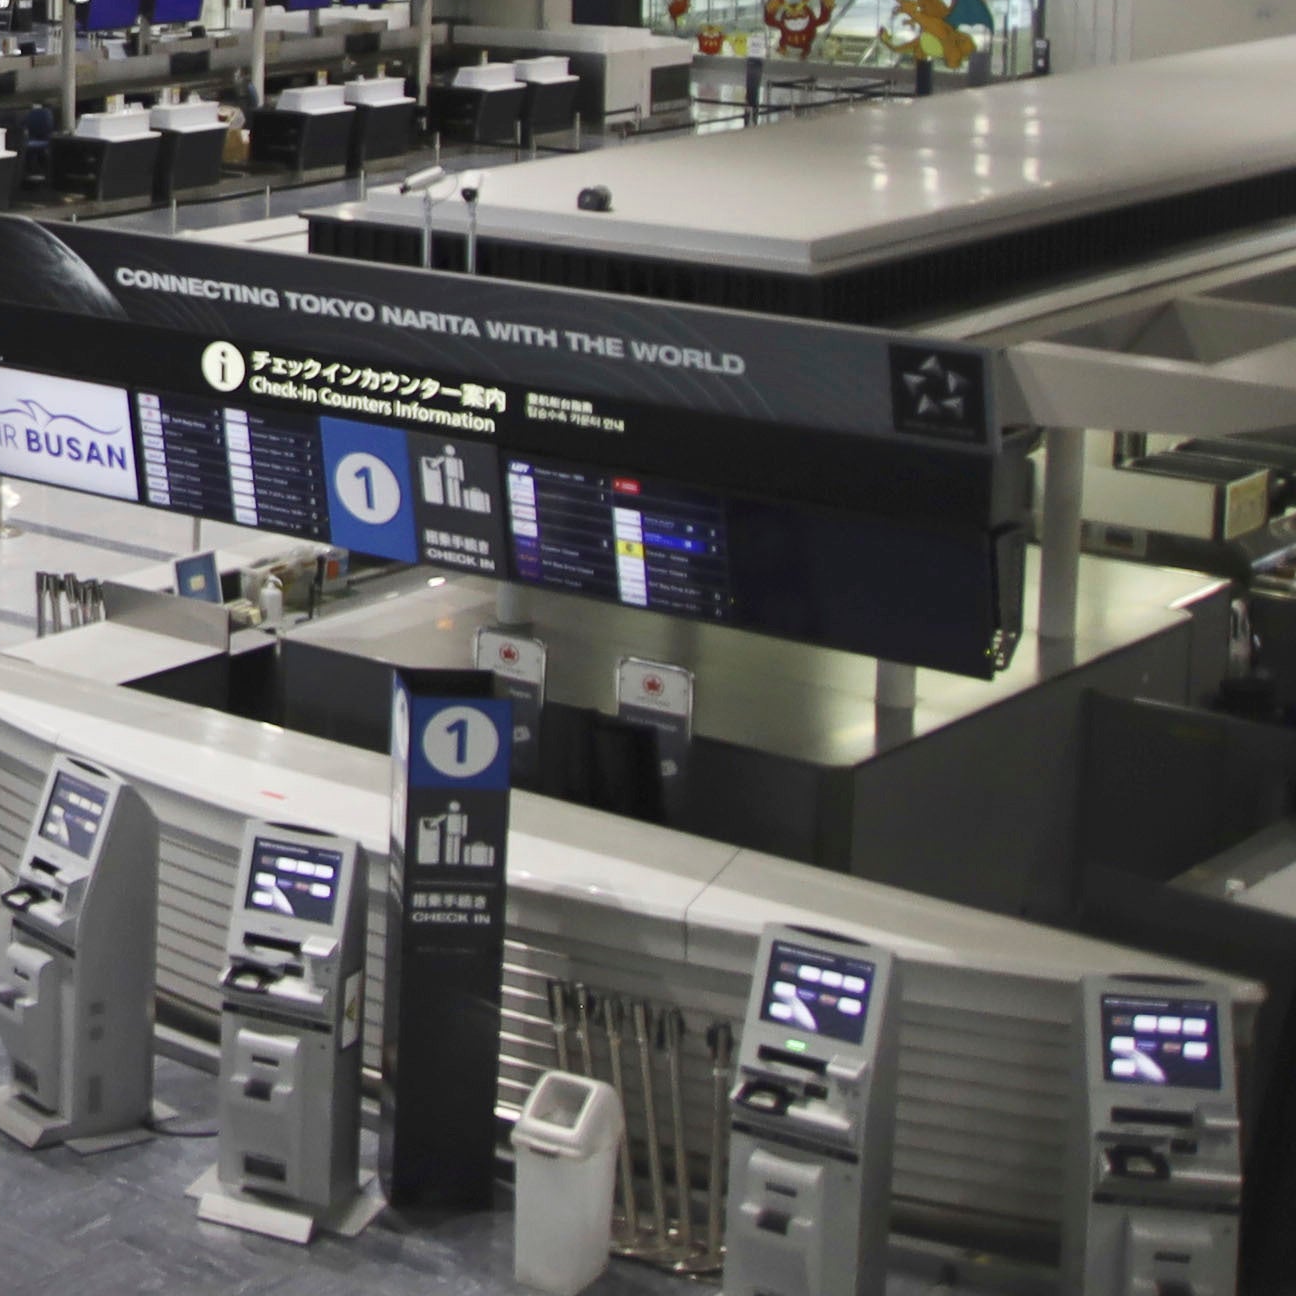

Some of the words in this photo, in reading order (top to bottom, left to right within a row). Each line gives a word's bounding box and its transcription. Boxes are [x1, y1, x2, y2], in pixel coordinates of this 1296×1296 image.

[116, 267, 279, 308] CONNECTING
[285, 291, 375, 323] TOKYO
[382, 305, 481, 338] NARITA
[485, 320, 559, 349] WITH
[565, 331, 625, 358] THE
[630, 341, 746, 376] WORLD
[249, 376, 318, 404] Check-in
[319, 386, 392, 416] Counters
[396, 400, 496, 434] Information
[251, 351, 507, 414] チェックインカウンター案内
[25, 428, 128, 471] BUSAN
[354, 466, 376, 511] 1
[426, 548, 478, 566] CHECK
[479, 558, 496, 571] IN
[444, 718, 469, 765] 1
[412, 911, 469, 924] CHECK
[473, 912, 491, 925] IN
